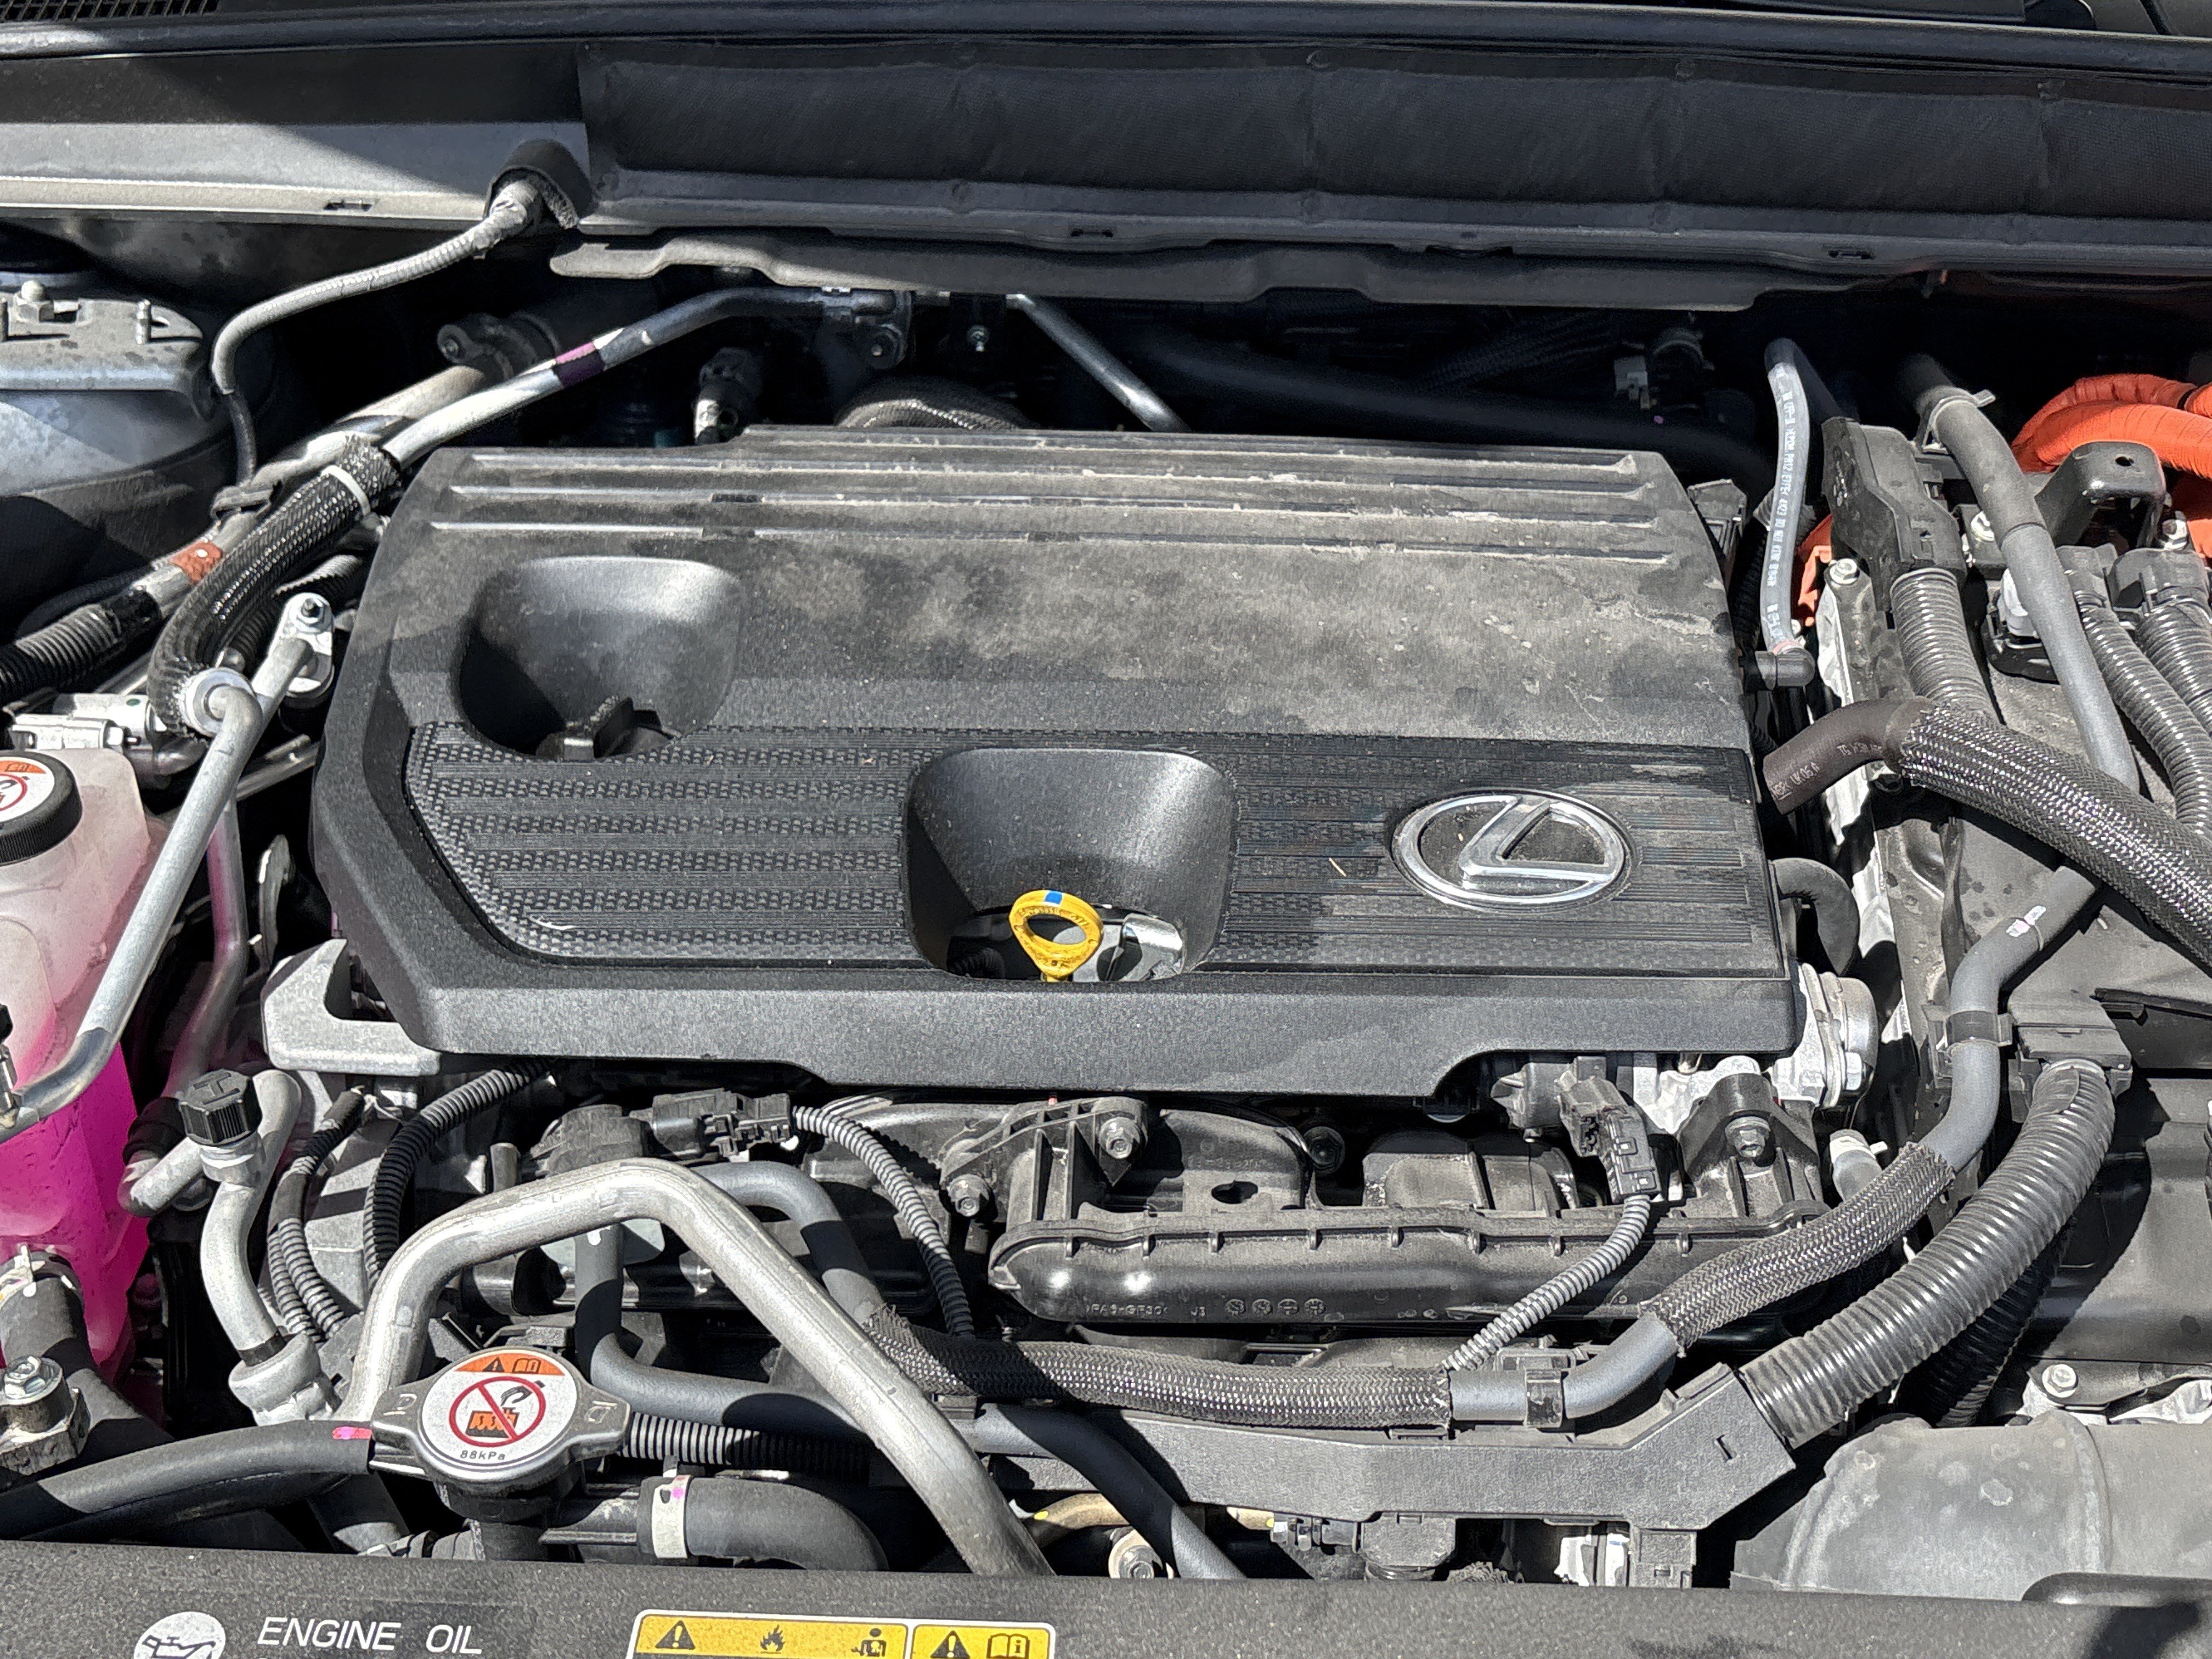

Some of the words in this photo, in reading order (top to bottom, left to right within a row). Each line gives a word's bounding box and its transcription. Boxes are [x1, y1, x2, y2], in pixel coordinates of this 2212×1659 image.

[460, 1450, 506, 1460] 88kPa
[257, 1616, 402, 1651] ENGINE
[426, 1624, 482, 1655] OIL
